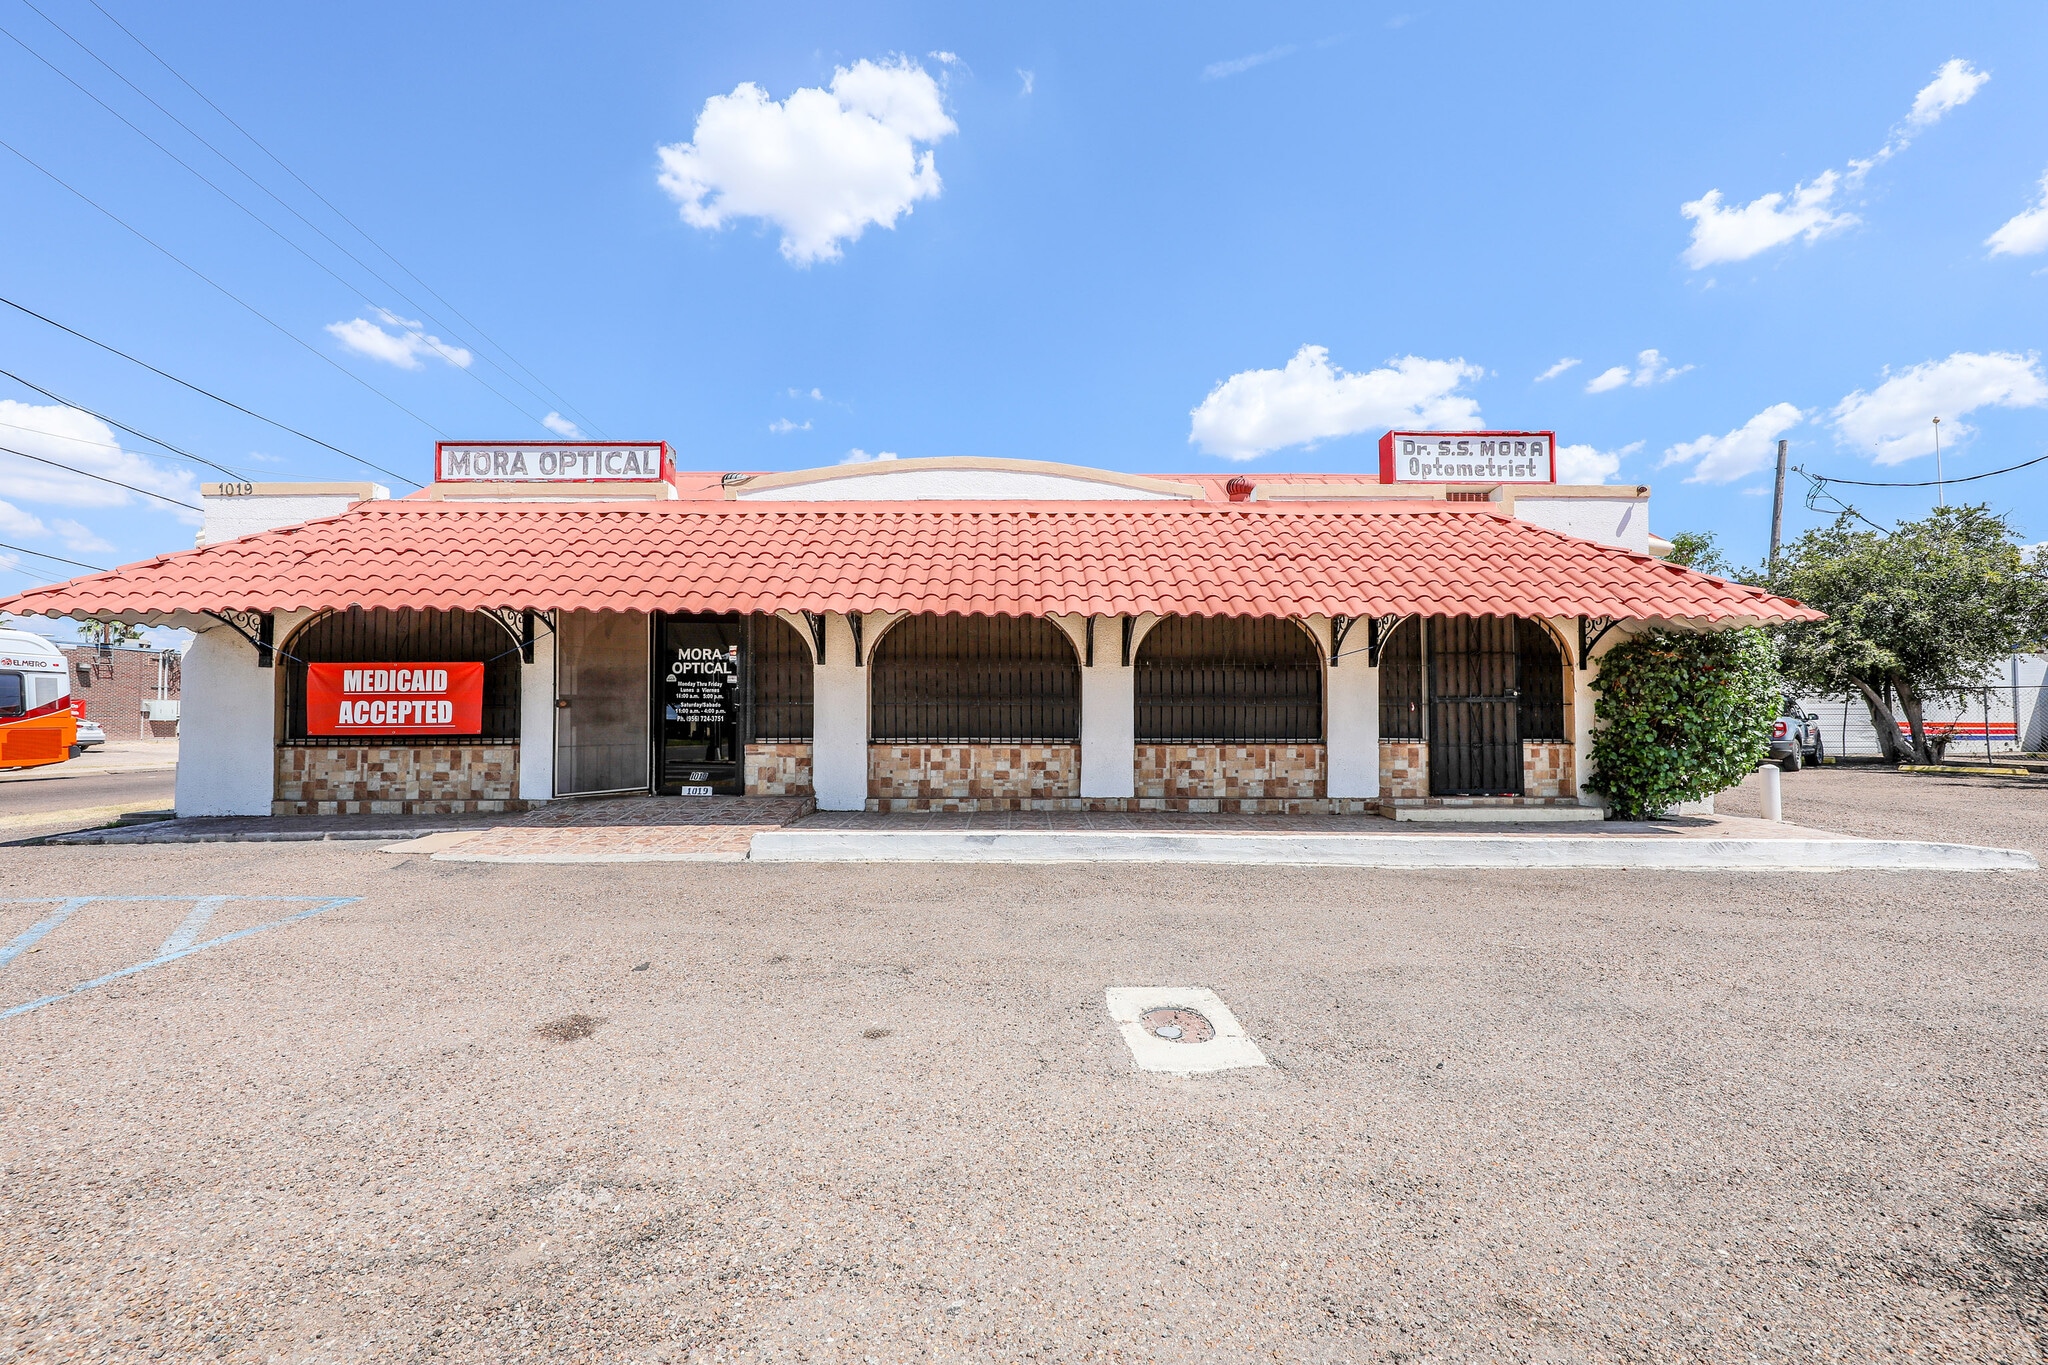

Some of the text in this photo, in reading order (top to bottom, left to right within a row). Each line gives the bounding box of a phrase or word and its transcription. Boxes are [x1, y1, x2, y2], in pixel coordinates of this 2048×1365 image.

[1403, 440, 1543, 457] Dr. S.S. MORA
[447, 450, 656, 476] MORA OPTICAL
[1409, 457, 1537, 479] Optometrist
[219, 482, 253, 497] 1019
[678, 648, 723, 661] MORA
[672, 661, 732, 674] OPTICAL
[343, 669, 448, 692] MEDICAID
[339, 700, 453, 725] ACCEPTED
[687, 787, 709, 795] 1019
